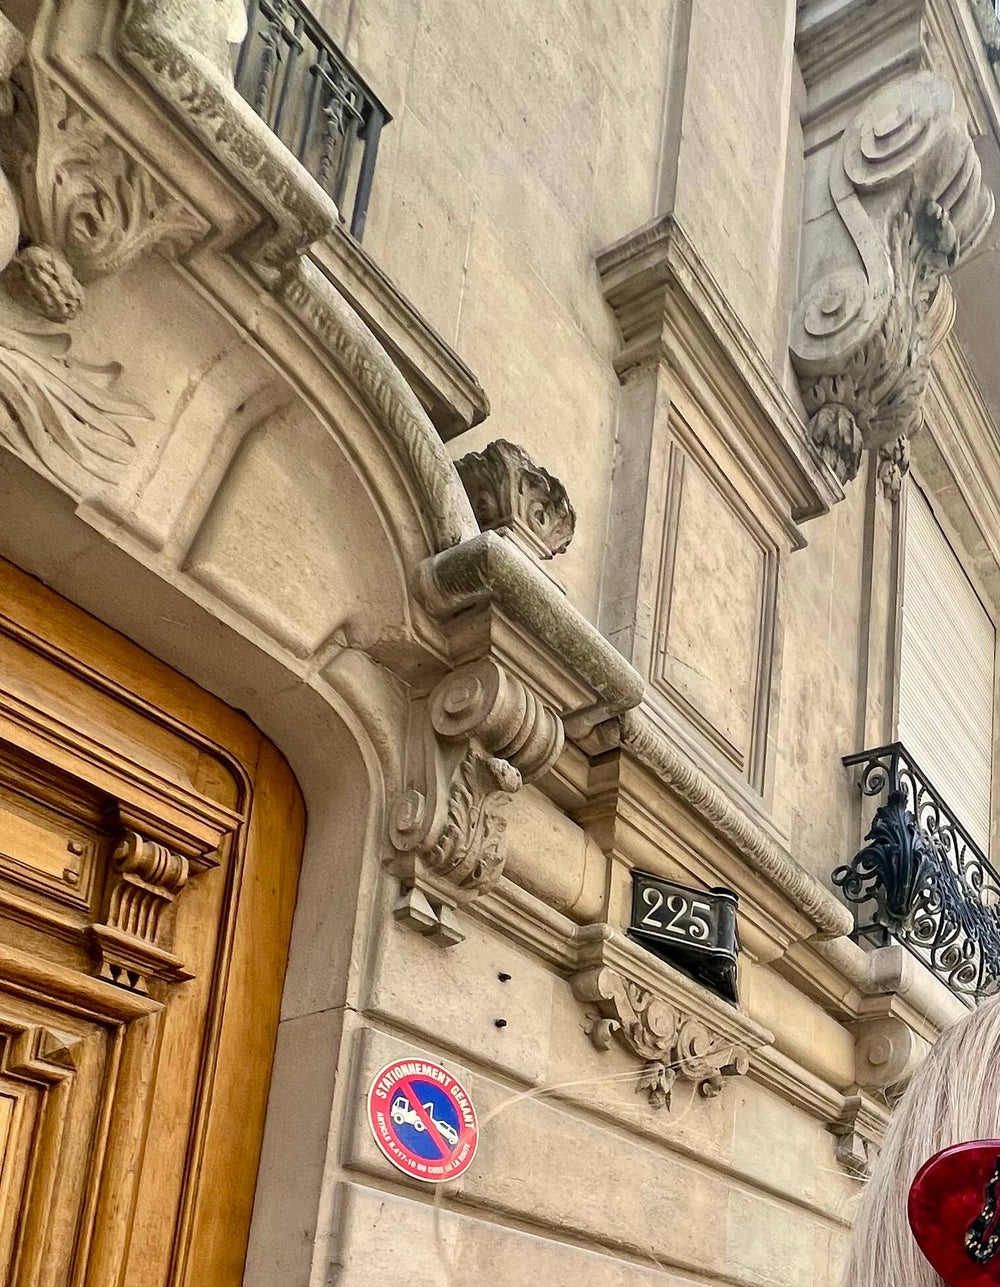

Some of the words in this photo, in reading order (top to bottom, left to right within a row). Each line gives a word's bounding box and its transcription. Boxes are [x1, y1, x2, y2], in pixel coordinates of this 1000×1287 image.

[642, 887, 711, 941] 225
[375, 1063, 452, 1099] STATIONNEMENT
[376, 1111, 392, 1142] ARTICLE
